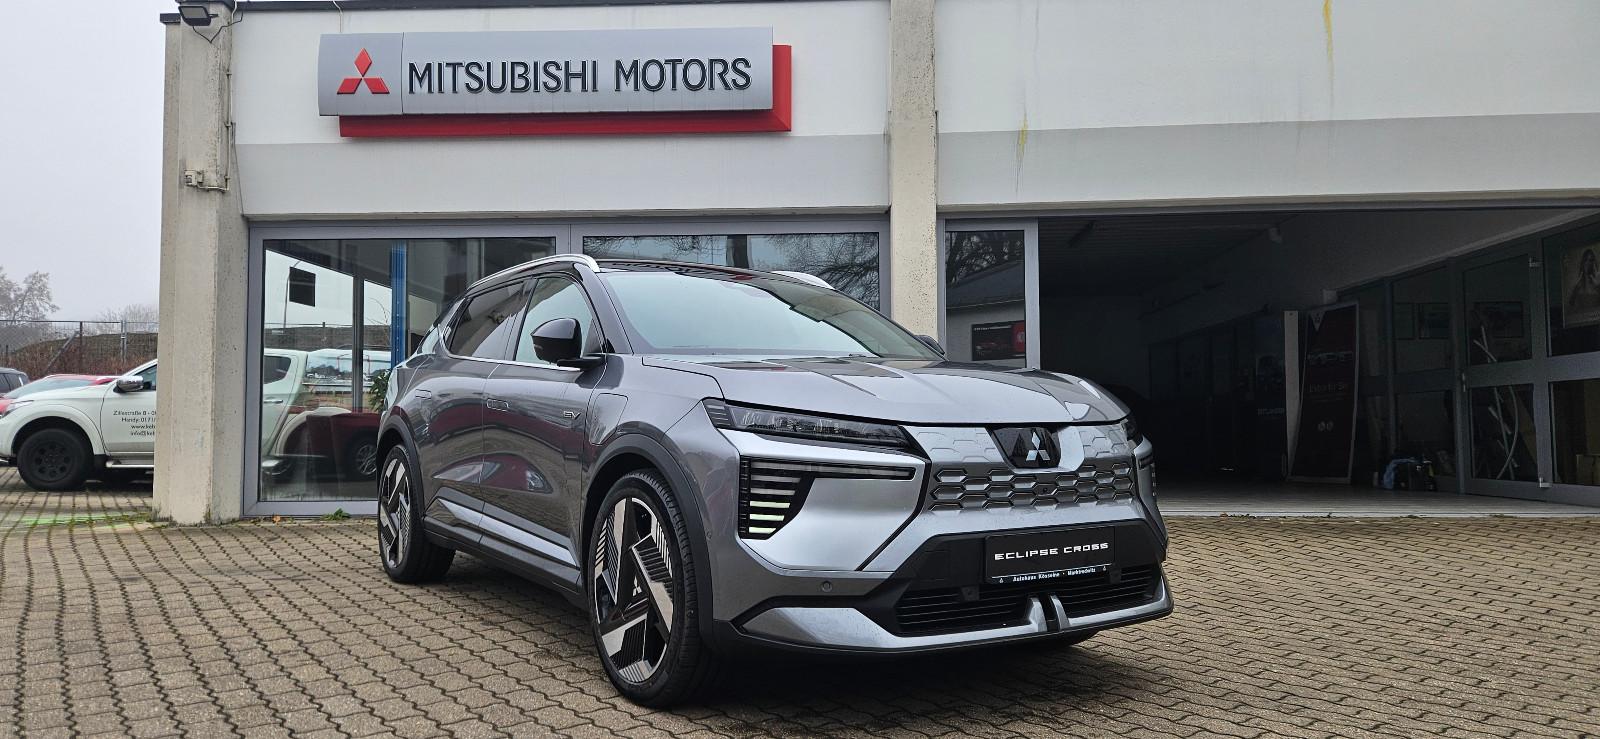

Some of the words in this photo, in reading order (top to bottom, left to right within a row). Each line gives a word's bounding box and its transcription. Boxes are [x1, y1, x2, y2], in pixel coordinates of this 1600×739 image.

[408, 60, 599, 94] MITSUBISHI
[614, 57, 753, 92] MOTORS
[563, 410, 582, 420] EV
[994, 548, 1059, 561] ECLIPSE
[1063, 542, 1109, 554] CROSS
